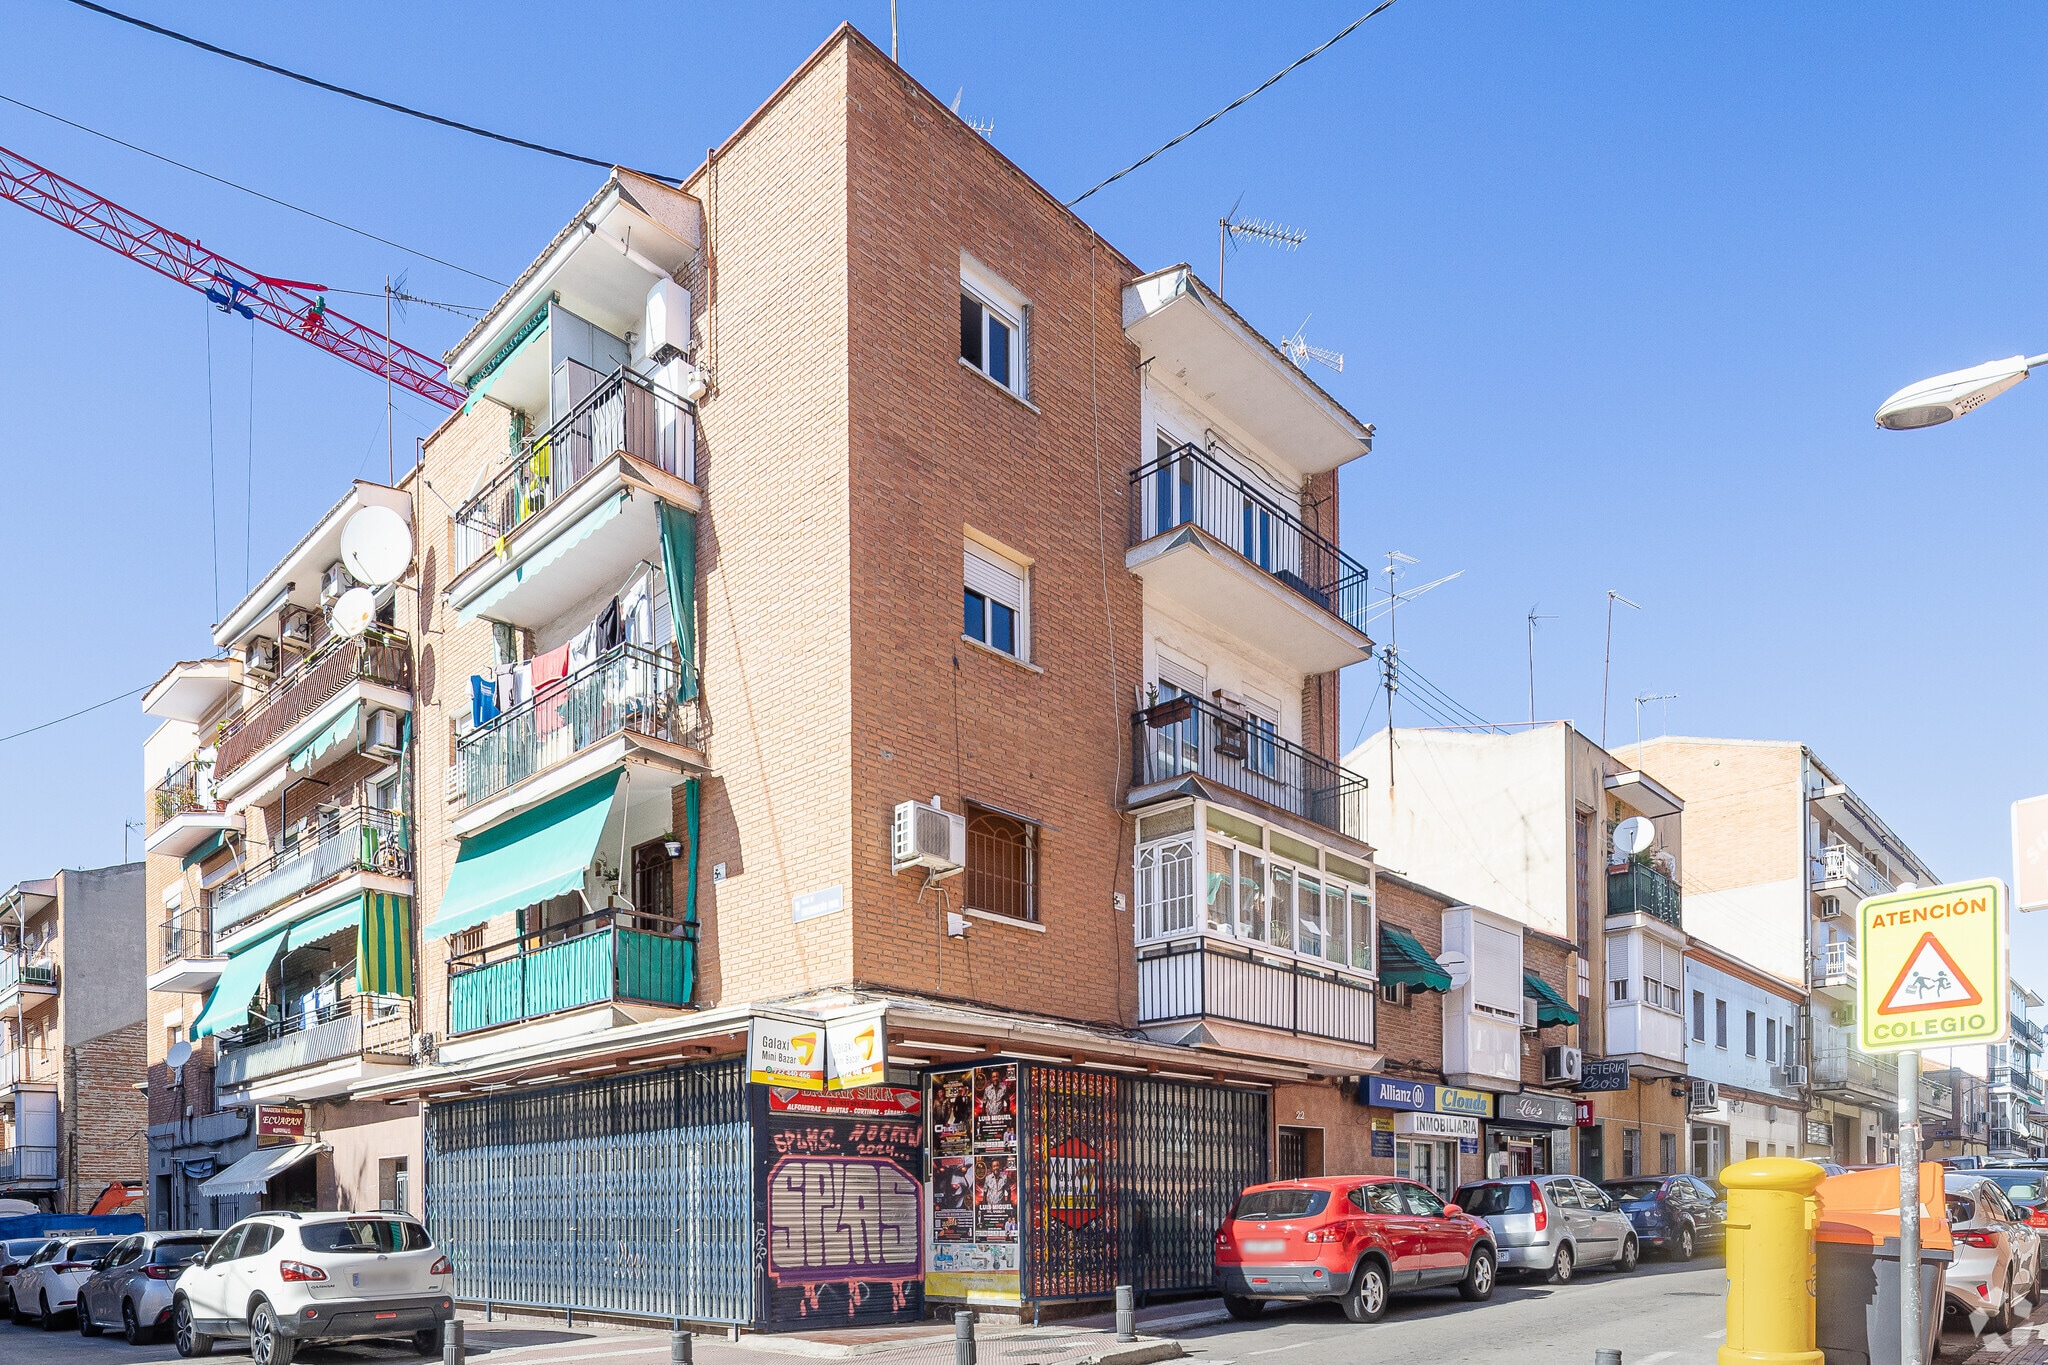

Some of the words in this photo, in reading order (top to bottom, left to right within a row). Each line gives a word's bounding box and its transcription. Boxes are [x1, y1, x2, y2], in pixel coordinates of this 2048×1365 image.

[1871, 897, 1987, 929] ATENCIÓN
[1873, 1014, 1986, 1040] COLEGIO
[762, 1035, 790, 1051] Galaxi
[762, 1050, 777, 1062] Mini
[778, 1052, 797, 1064] Bazar
[1581, 1062, 1625, 1075] AFETERIA
[1380, 1083, 1412, 1103] Allianz
[1442, 1089, 1487, 1111] Clouds
[786, 1103, 822, 1113] ALFOMBRAS
[826, 1105, 849, 1114] MANTAS
[853, 1107, 880, 1115] CORTINAS
[1295, 1110, 1305, 1120] 22
[1515, 1099, 1543, 1118] Leo's
[262, 1115, 303, 1126] ECUAPAN
[1416, 1115, 1477, 1135] INMOBILIARIA
